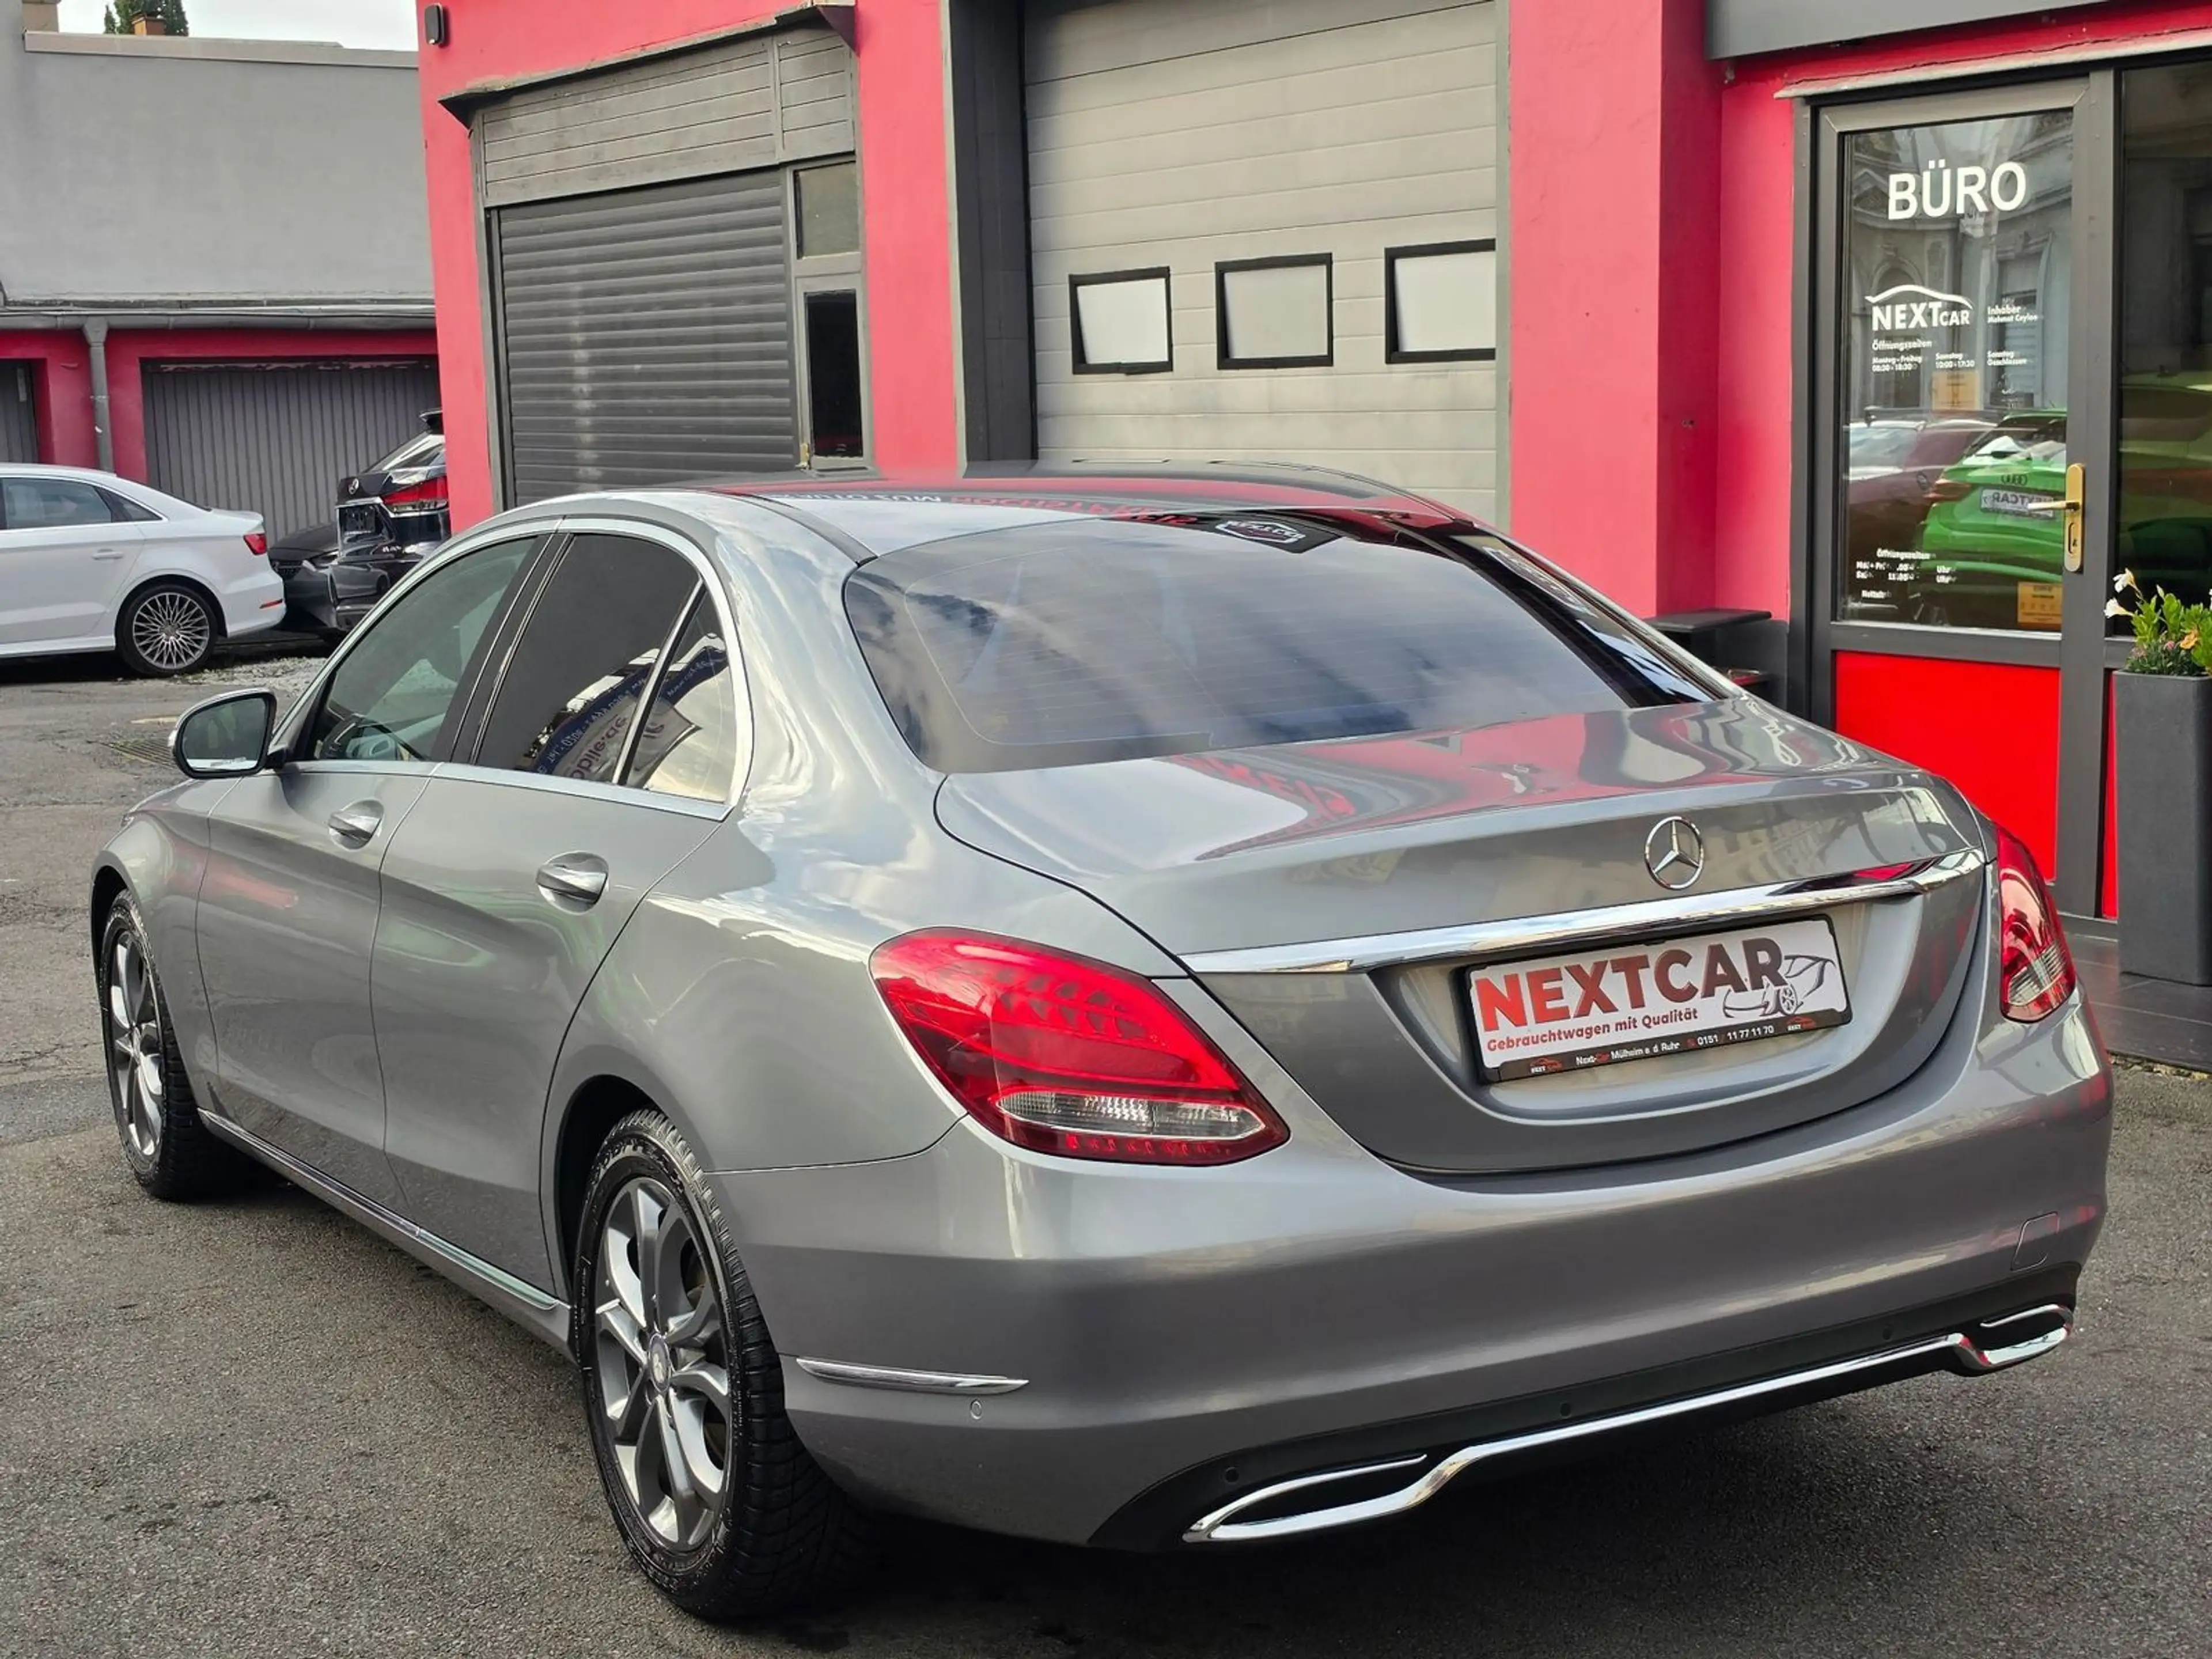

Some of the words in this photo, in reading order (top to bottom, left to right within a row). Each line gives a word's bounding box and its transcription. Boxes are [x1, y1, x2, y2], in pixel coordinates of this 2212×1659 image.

[1888, 159, 2026, 220] BÜRO
[1872, 301, 1970, 330] NEXTCAR
[1872, 339, 1932, 351] Öffnungszeiten
[1474, 937, 1786, 1032] NEXTCAR
[1487, 1024, 1611, 1052] Gebrauchtwagen
[1615, 1016, 1638, 1032] mit
[1641, 1007, 1698, 1029] Qualität
[1697, 1035, 1718, 1046] 0151
[1662, 1041, 1680, 1052] Ruhr
